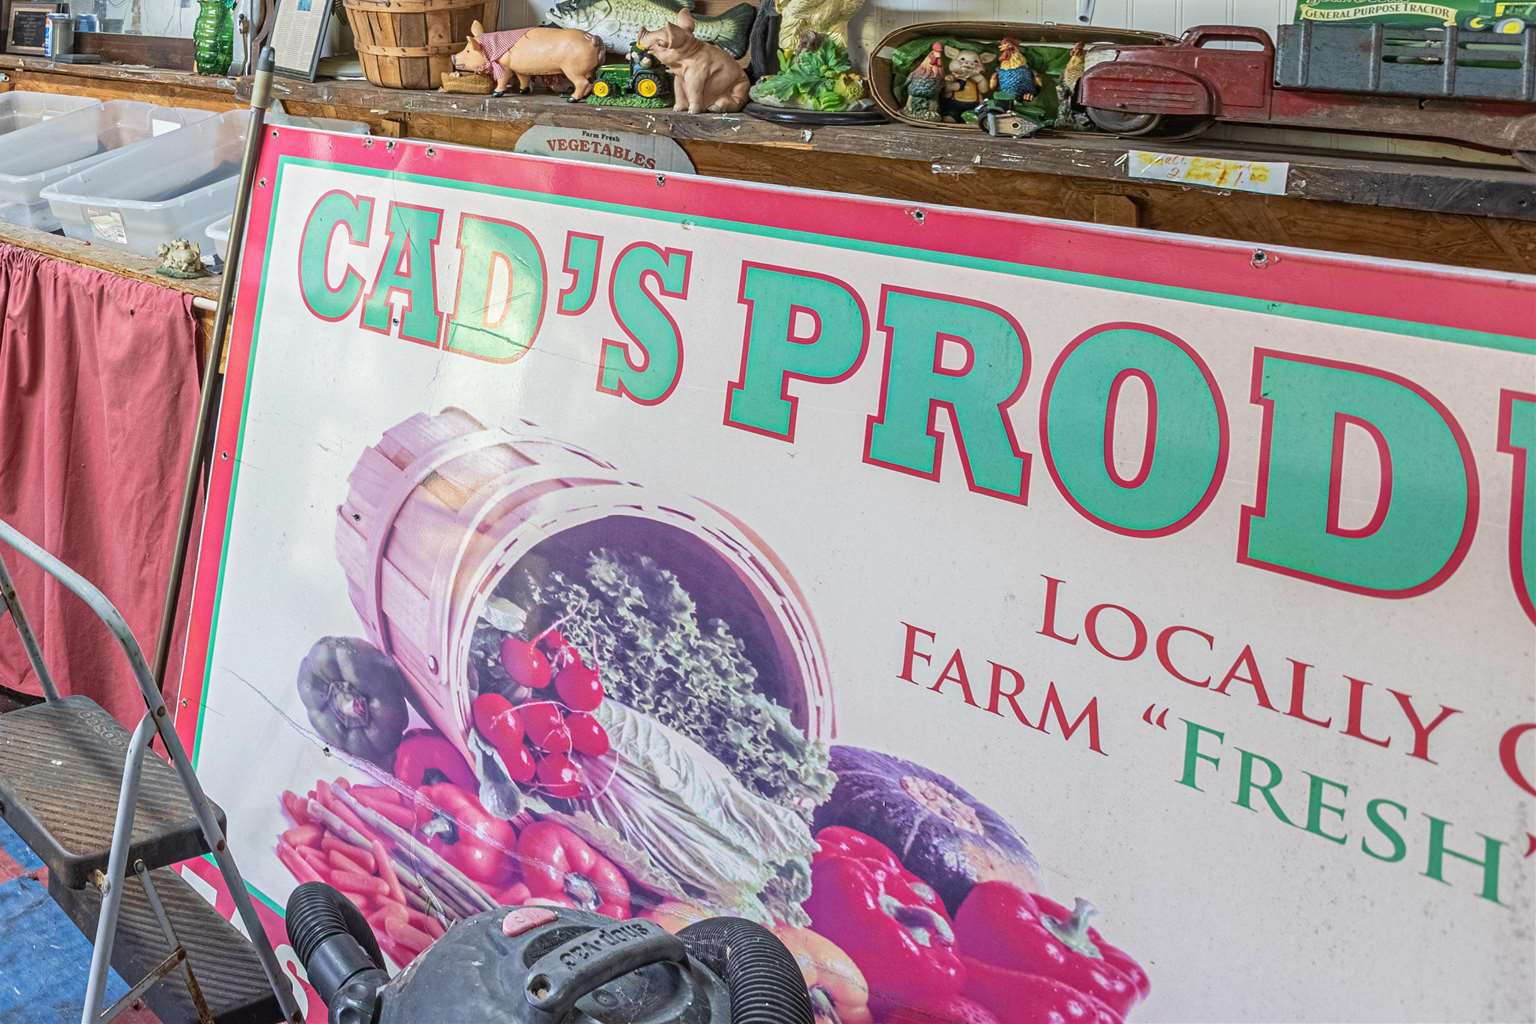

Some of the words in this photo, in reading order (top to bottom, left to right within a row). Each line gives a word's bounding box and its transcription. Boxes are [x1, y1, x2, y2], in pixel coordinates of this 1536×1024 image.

[1304, 7, 1353, 19] GENERAL
[1353, 4, 1402, 17] PURPOSE
[1403, 2, 1450, 17] TRACTOR
[546, 138, 657, 170] VEGETABLES
[581, 130, 600, 139] Farm
[601, 133, 621, 143] Fresh
[298, 188, 693, 407] CAD'S
[1035, 574, 1464, 765] LOCALLY
[895, 620, 1109, 756] FARM
[1142, 702, 1536, 909] “FRESH
